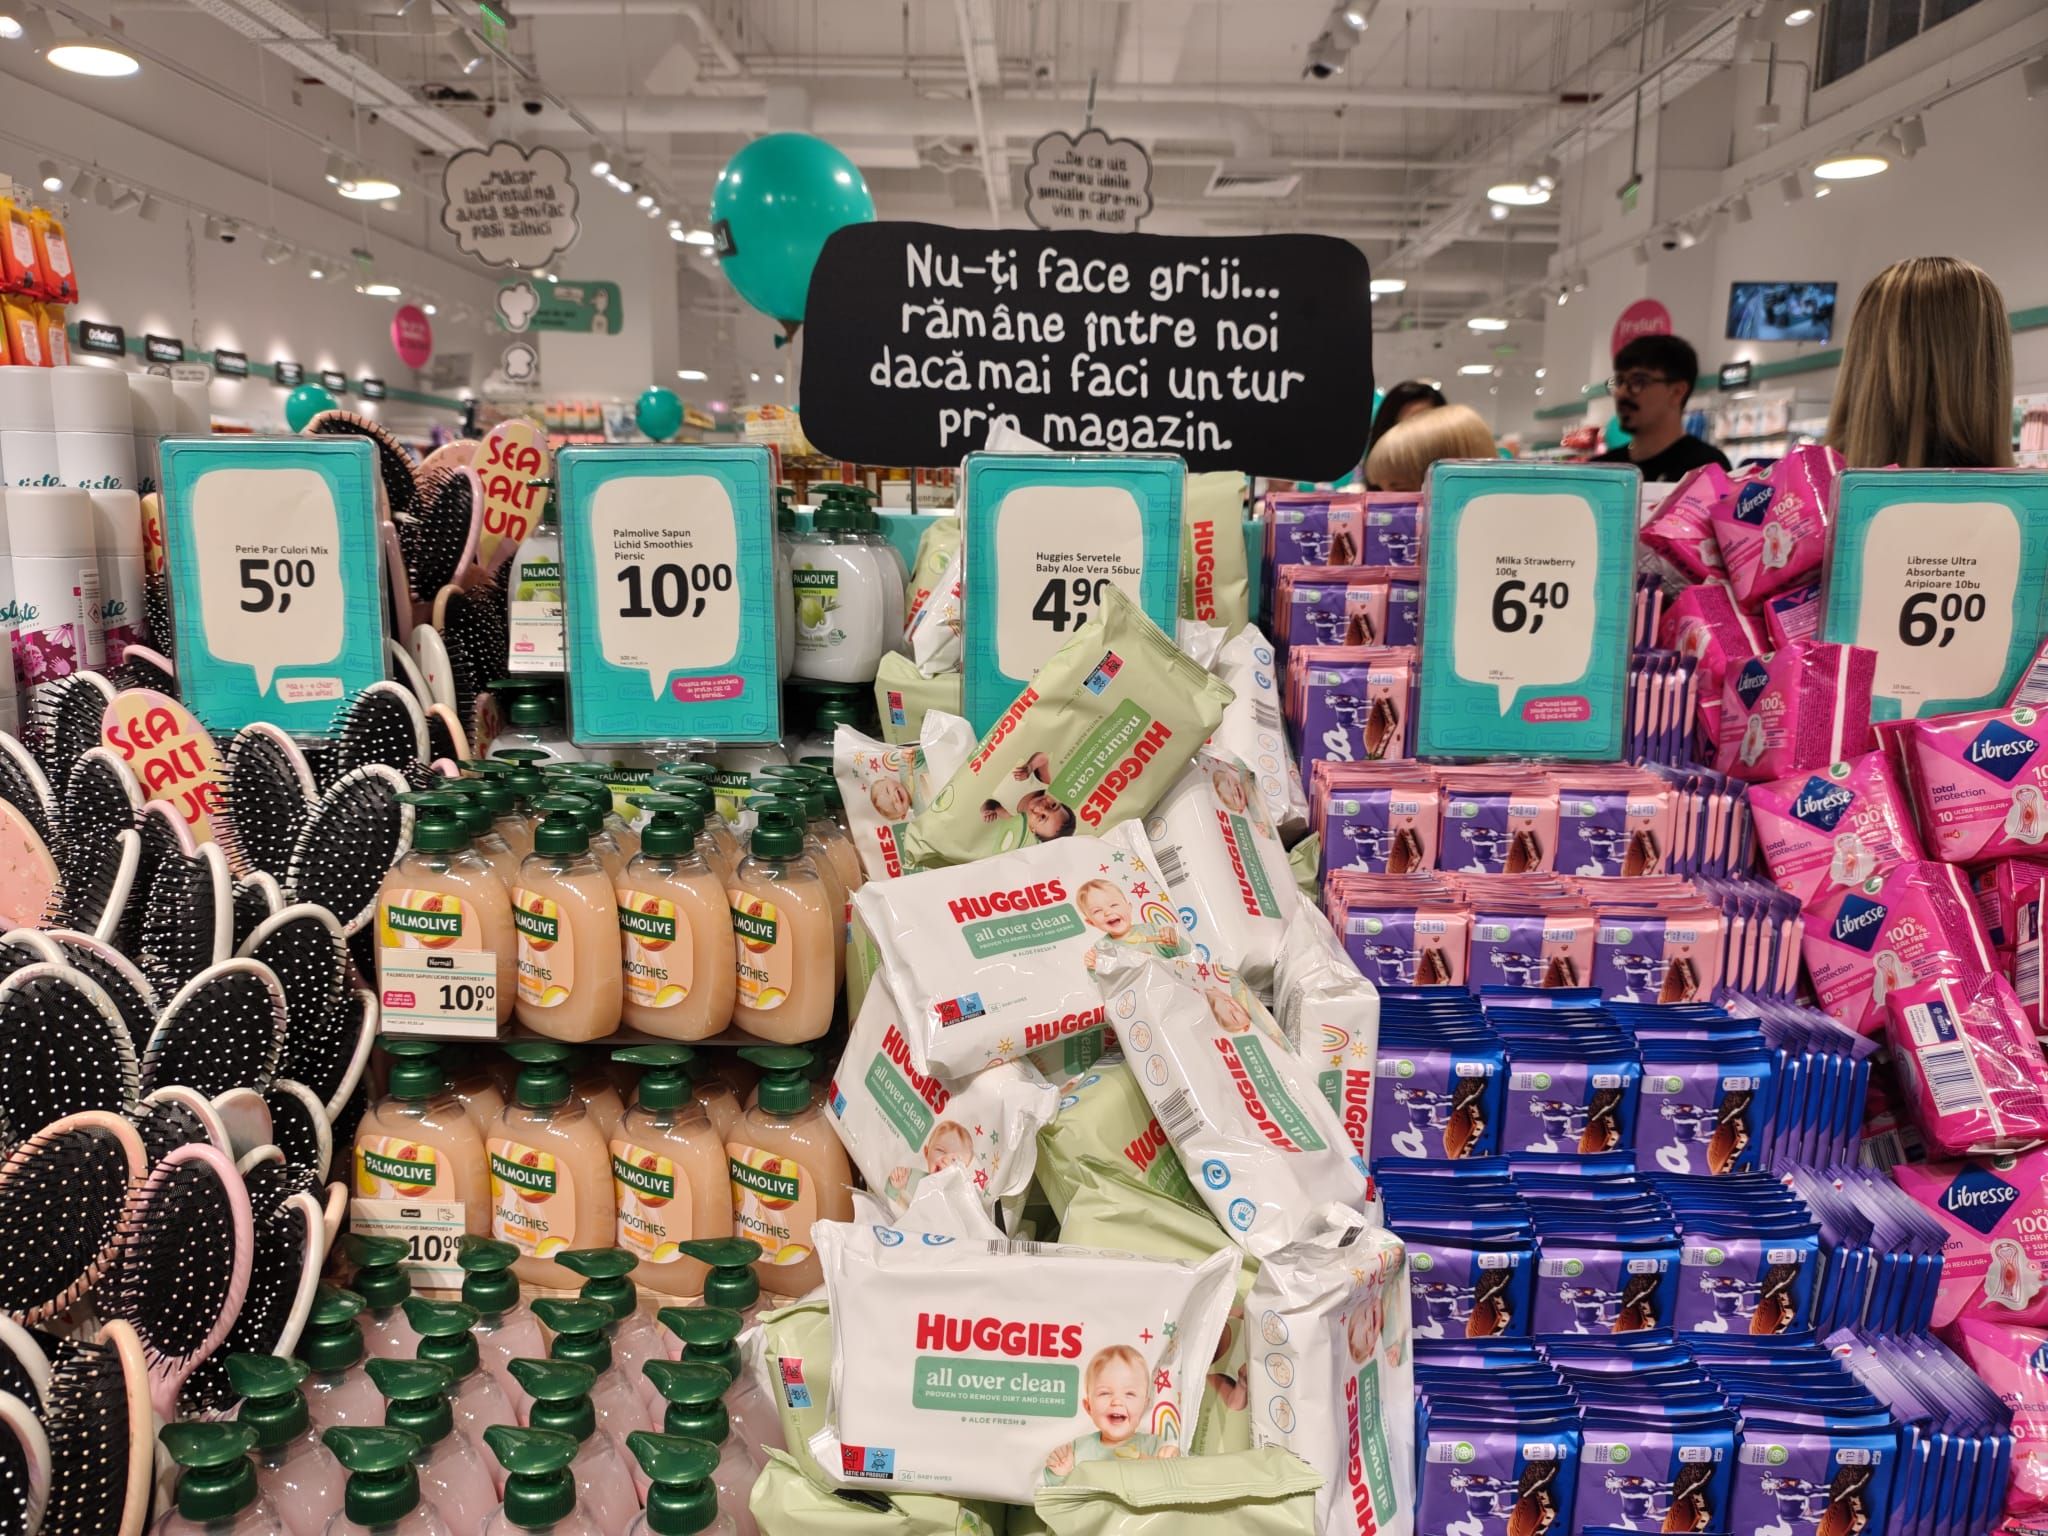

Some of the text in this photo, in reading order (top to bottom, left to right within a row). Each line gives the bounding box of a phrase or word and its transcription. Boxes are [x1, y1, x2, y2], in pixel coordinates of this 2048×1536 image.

[1037, 248, 1131, 293] face
[901, 297, 1279, 352] rămâne între noi
[869, 344, 1305, 404] dacă mai faci un tur
[1043, 410, 1233, 452] magazin.
[487, 436, 541, 476] SEA
[613, 528, 691, 540] Palmolive Sapun
[614, 540, 693, 550] Lichid Smoothies
[235, 544, 328, 555] Perie Par Culori Mix
[614, 551, 645, 561] Piersic
[1036, 552, 1121, 563] Huggies Servetele
[1496, 556, 1575, 568] Milka Strawberry
[1907, 556, 1977, 566] Libresse Ultra
[523, 567, 560, 578] PALMOL
[793, 574, 835, 586] PALMOLIVE
[1036, 564, 1141, 575] Baby Aloe Vera 56buc
[1193, 519, 1216, 622] HUGGIES
[1495, 567, 1518, 577] 100g
[1906, 568, 1965, 577] Absorbante
[240, 558, 315, 613] 5,00
[617, 563, 732, 618] 10,00
[1904, 579, 1980, 589] Aripioare 10bu
[1492, 579, 1569, 634] 6,40
[1899, 592, 1986, 648] 6,00
[106, 707, 179, 761] SEA
[969, 687, 1039, 773] HUGGIES
[1092, 714, 1141, 769] natural
[1971, 739, 2036, 763] Libresse
[140, 739, 206, 800] ALT
[1067, 766, 1096, 799] care
[1080, 720, 1172, 827] HUGGIES
[1932, 783, 1956, 795] total
[1933, 787, 1986, 804] protection
[1796, 789, 1852, 818] Libresse
[1938, 811, 1953, 823] 10
[1766, 838, 1786, 852] total
[1768, 840, 1812, 859] protection
[1215, 808, 1261, 917] HUGGIES
[1774, 864, 1786, 876] 10
[947, 878, 1067, 923] HUGGIES
[390, 911, 457, 932] PALMOLIVE
[975, 913, 1071, 942] all over clean
[1834, 904, 1885, 940] Libresse
[1812, 963, 1831, 979] total
[1814, 961, 1855, 986] protection
[440, 984, 495, 1012] 10,00
[1822, 991, 1833, 1004] 10
[1024, 1005, 1106, 1048] HUGGI
[874, 1065, 888, 1083] all
[884, 1079, 904, 1104] over
[902, 1101, 927, 1133] clean
[1214, 1037, 1303, 1153] HUGGIES
[1244, 1045, 1311, 1145] all over clean
[366, 1156, 431, 1181] PALMOLIVE
[493, 1158, 551, 1188] PALMOLIVE
[614, 1161, 670, 1193] PALMOLIVE
[732, 1163, 794, 1195] PALMOLIVE
[1947, 1185, 2015, 1211] Libresse
[495, 1204, 549, 1232] SMOOTHIES
[734, 1210, 790, 1240] SMOOTHIES
[2019, 1232, 2043, 1243] LEAK
[915, 1312, 1082, 1360] HUGGIES
[926, 1367, 1066, 1394] all over clean
[925, 1390, 1066, 1405] PROVEN TO REMOVE DIRT AND GERMS
[1364, 1377, 1374, 1431] clean
[968, 1416, 1019, 1426] ALOE FRESH
[1368, 1436, 1383, 1481] over
[1688, 1448, 1697, 1460] 113
[1845, 1451, 1855, 1462] 113
